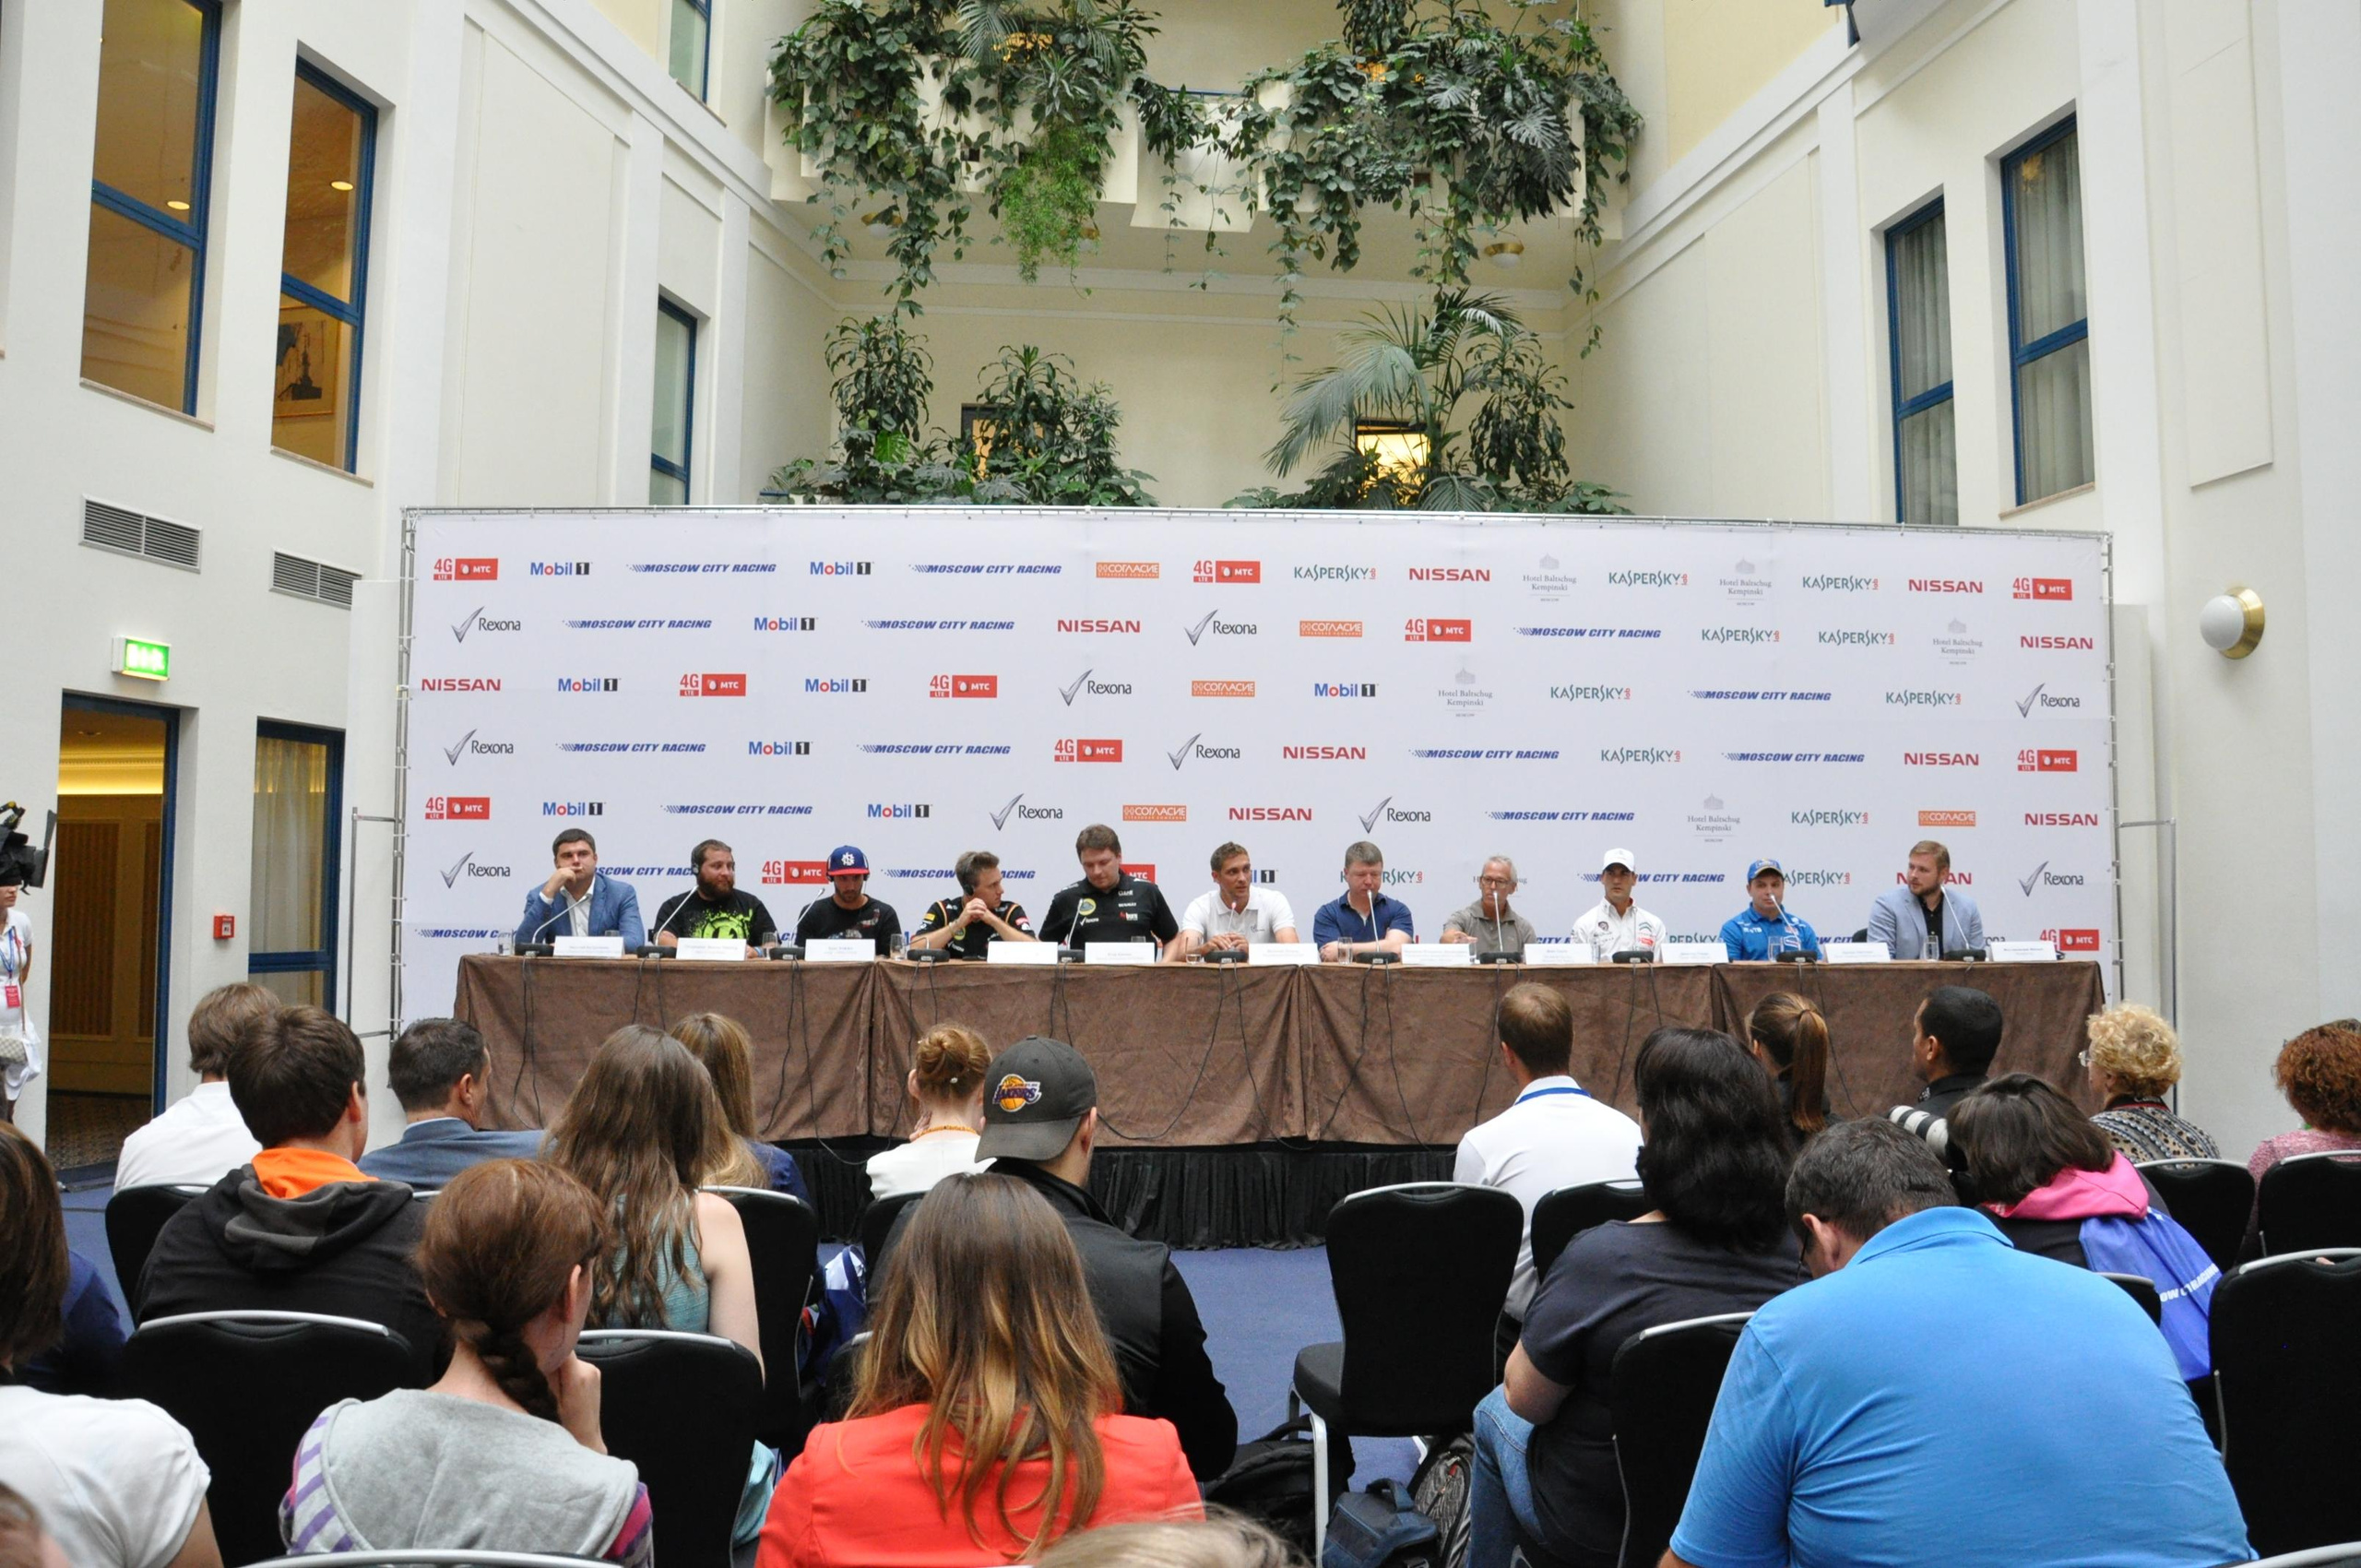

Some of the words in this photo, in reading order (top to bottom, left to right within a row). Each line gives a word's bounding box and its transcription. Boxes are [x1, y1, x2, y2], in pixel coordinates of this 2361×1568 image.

[434, 559, 452, 575] 4G
[530, 563, 572, 576] Mobil
[577, 564, 588, 575] 1
[811, 562, 853, 575] Mobil
[859, 563, 870, 574] 1
[1017, 565, 1062, 574] RACING
[1109, 564, 1158, 573] СОГЛАСИЕ
[1193, 561, 1213, 576] 4G
[1295, 564, 1369, 582] KASPERSKY
[1409, 568, 1489, 581] NISSAN
[1523, 575, 1542, 583] Hotel
[1609, 570, 1680, 587] KASPERSKY
[1532, 583, 1568, 592] Kempinski
[1803, 575, 1871, 591] KASPERSKY
[1909, 579, 1982, 593] NISSAN
[2013, 578, 2030, 594] 4G
[1728, 588, 1763, 596] Kempinski
[479, 618, 520, 631] Rexona
[638, 620, 665, 628] CITY
[754, 618, 797, 630] Mobil
[802, 618, 813, 629] 1
[940, 621, 967, 629] CITY
[1058, 620, 1140, 633] NISSAN
[1214, 621, 1256, 635] Rexona
[1311, 624, 1361, 632] СОГЛАСИЕ
[1406, 619, 1424, 636] 4G
[1531, 628, 1586, 636] MOSCOW
[1703, 627, 1773, 644] KASPERSKY
[1819, 630, 1887, 647] KASPERSKY
[2021, 636, 2093, 649] NISSAN
[1941, 647, 1975, 655] Kempinski
[421, 679, 500, 691] NISSAN
[558, 679, 600, 692] Mobil
[606, 680, 616, 691] 1
[681, 674, 698, 688] 4G
[805, 679, 848, 692] Mobil
[854, 681, 865, 692] 1
[930, 675, 949, 689] 4G
[1088, 681, 1132, 694] Rexona
[1204, 683, 1254, 692] СОГЛАСИЕ
[1315, 683, 1358, 696] Mobil
[1363, 684, 1374, 695] 1
[1551, 684, 1623, 702] KASPERSKY
[1705, 691, 1759, 699] MOSCOW
[1447, 698, 1484, 707] Kempinski
[1886, 690, 1954, 707] KASPERSKY
[2041, 694, 2080, 707] Rexona
[471, 741, 514, 754] Rexona
[574, 743, 629, 752] MOSCOW
[632, 743, 658, 752] CITY
[749, 742, 791, 754] Mobil
[797, 742, 808, 754] 1
[935, 745, 963, 754] CITY
[1055, 739, 1074, 755] 4G
[1196, 744, 1240, 758] Rexona
[1284, 746, 1365, 759] NISSAN
[1428, 750, 1483, 758] MOSCOW
[1515, 751, 1559, 759] RACING
[1602, 747, 1673, 764] KASPERSKY
[1904, 753, 1978, 766] NISSAN
[2018, 750, 2035, 766] 4G
[426, 797, 444, 814] 4G
[543, 802, 585, 815] Mobil
[590, 803, 601, 814] 1
[679, 805, 735, 814] MOSCOW
[868, 804, 911, 817] Mobil
[917, 805, 928, 816] 1
[1019, 805, 1062, 819] Rexona
[1135, 807, 1185, 816] СОГЛАСИЕ
[1229, 808, 1311, 821] NISSAN
[1387, 808, 1430, 822] Rexona
[1503, 812, 1560, 820] MOSCOW
[1688, 814, 1706, 823] Hotel
[1792, 810, 1861, 826] KASPERSKY
[1929, 813, 1975, 821] СОГЛАСИЕ
[2025, 814, 2097, 826] NISSAN
[1696, 824, 1732, 833] Kempinski
[469, 863, 510, 876] Rexona
[595, 867, 634, 876] SCOW
[637, 867, 664, 876] CITY
[763, 861, 781, 875] 4G
[898, 869, 955, 878] MOSCOW
[1001, 871, 1035, 879] ACING
[1263, 870, 1274, 883] 1
[1653, 873, 1679, 883] CITY
[1682, 873, 1726, 883] RACING
[1784, 870, 1844, 886] ASPERSKY
[2045, 872, 2083, 885] Rexona
[433, 930, 488, 938] MOSCOW
[2040, 930, 2057, 943] 4G
